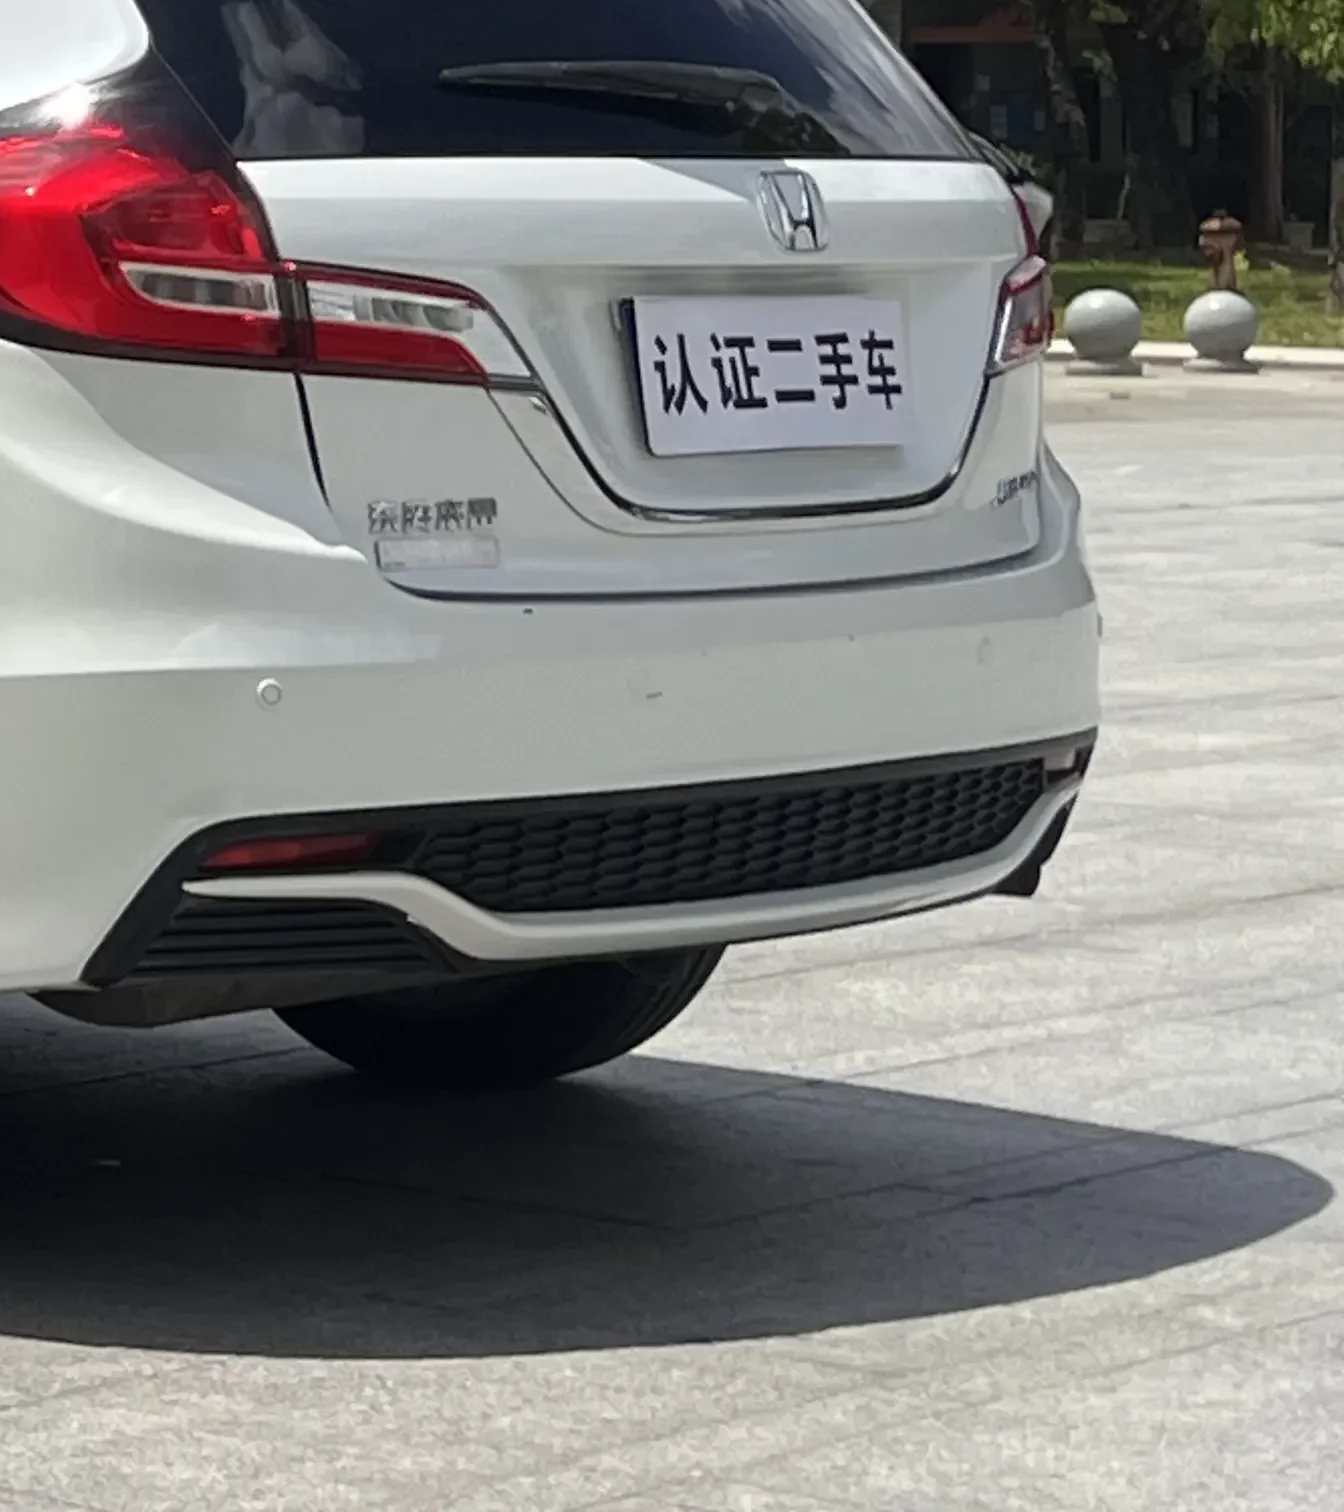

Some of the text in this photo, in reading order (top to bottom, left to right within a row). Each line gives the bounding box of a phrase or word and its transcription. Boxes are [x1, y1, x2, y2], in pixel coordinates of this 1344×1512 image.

[653, 330, 903, 415] 认证二手车
